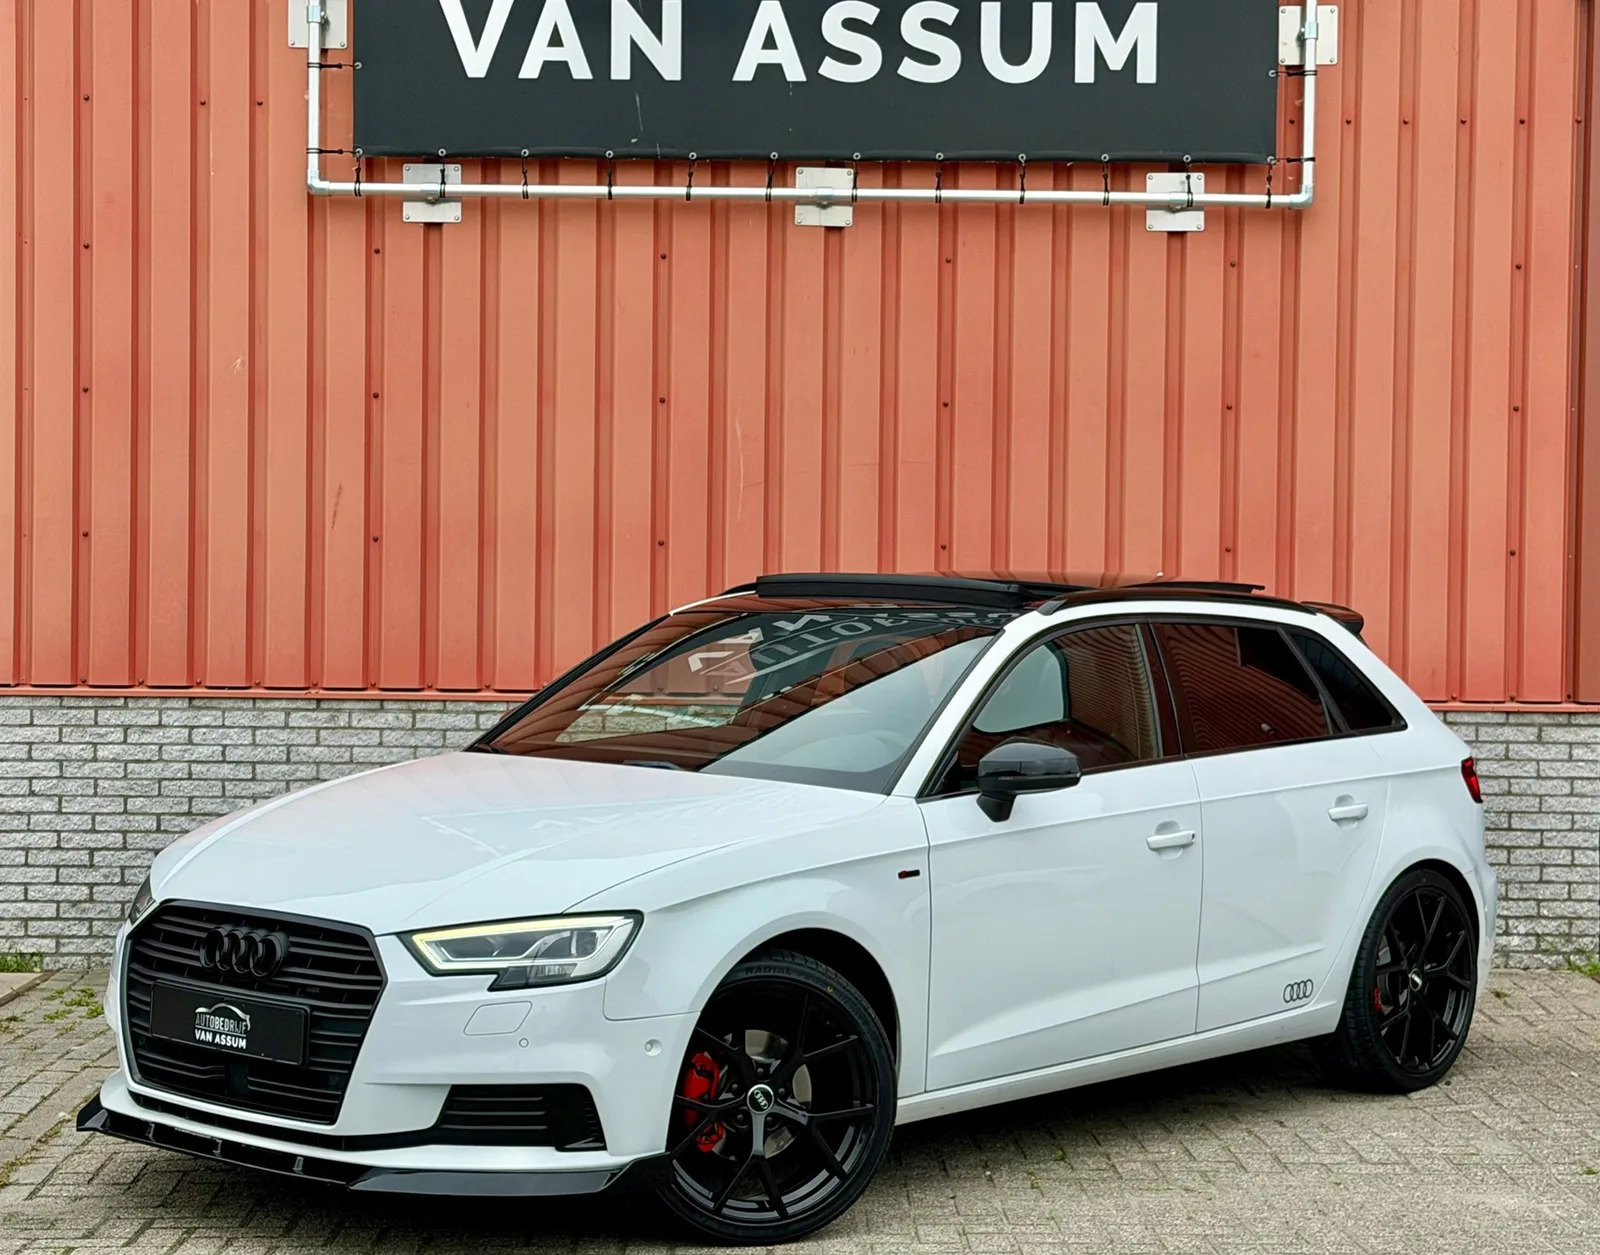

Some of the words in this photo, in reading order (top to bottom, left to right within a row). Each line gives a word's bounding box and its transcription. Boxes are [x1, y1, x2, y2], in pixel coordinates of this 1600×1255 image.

[438, 0, 682, 81] VAN
[732, 0, 1158, 84] ASSUM
[195, 1013, 247, 1034] AUTOBEDRIJF
[195, 1028, 213, 1042] VAN
[214, 1033, 247, 1049] ASSUM
